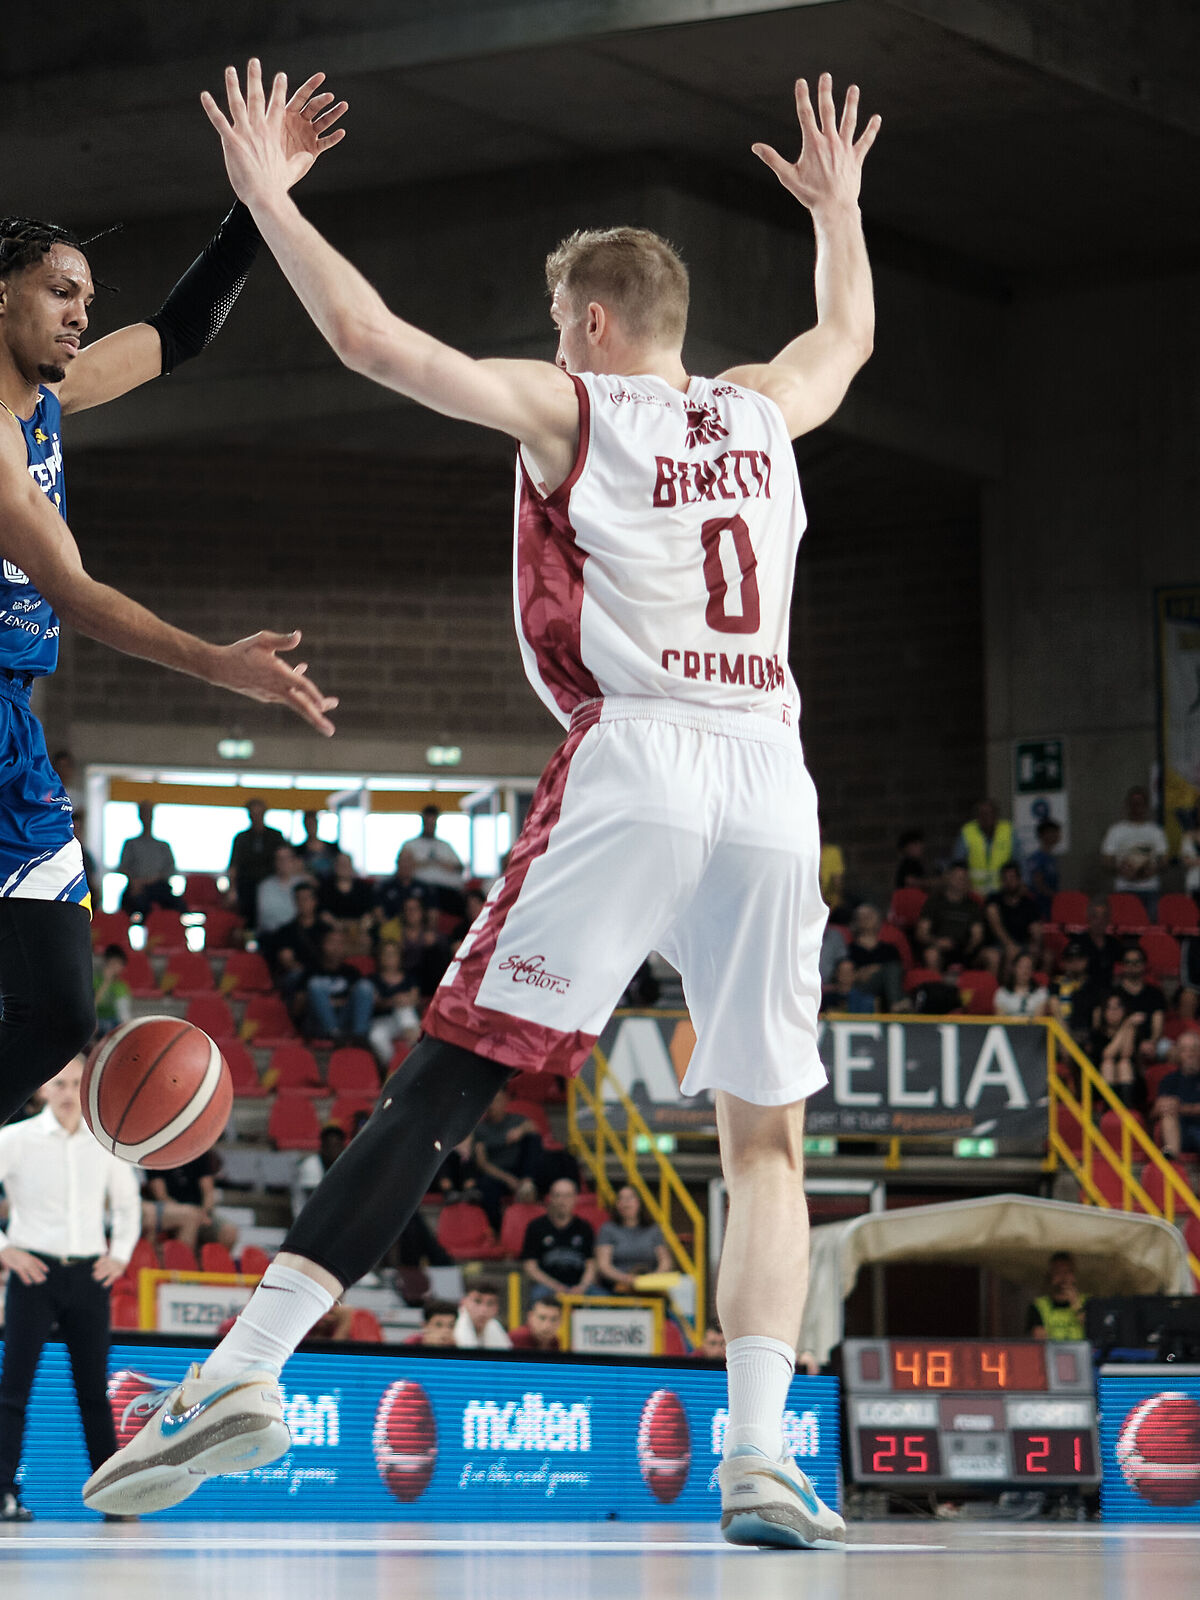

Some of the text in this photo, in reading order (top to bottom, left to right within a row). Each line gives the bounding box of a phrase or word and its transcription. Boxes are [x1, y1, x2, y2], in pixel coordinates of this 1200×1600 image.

[653, 450, 772, 508] BENETTI
[701, 514, 761, 635] 0
[895, 1351, 1007, 1388] 48 4
[462, 1392, 592, 1452] molten
[873, 1435, 929, 1473] 25
[1025, 1435, 1082, 1473] 21
